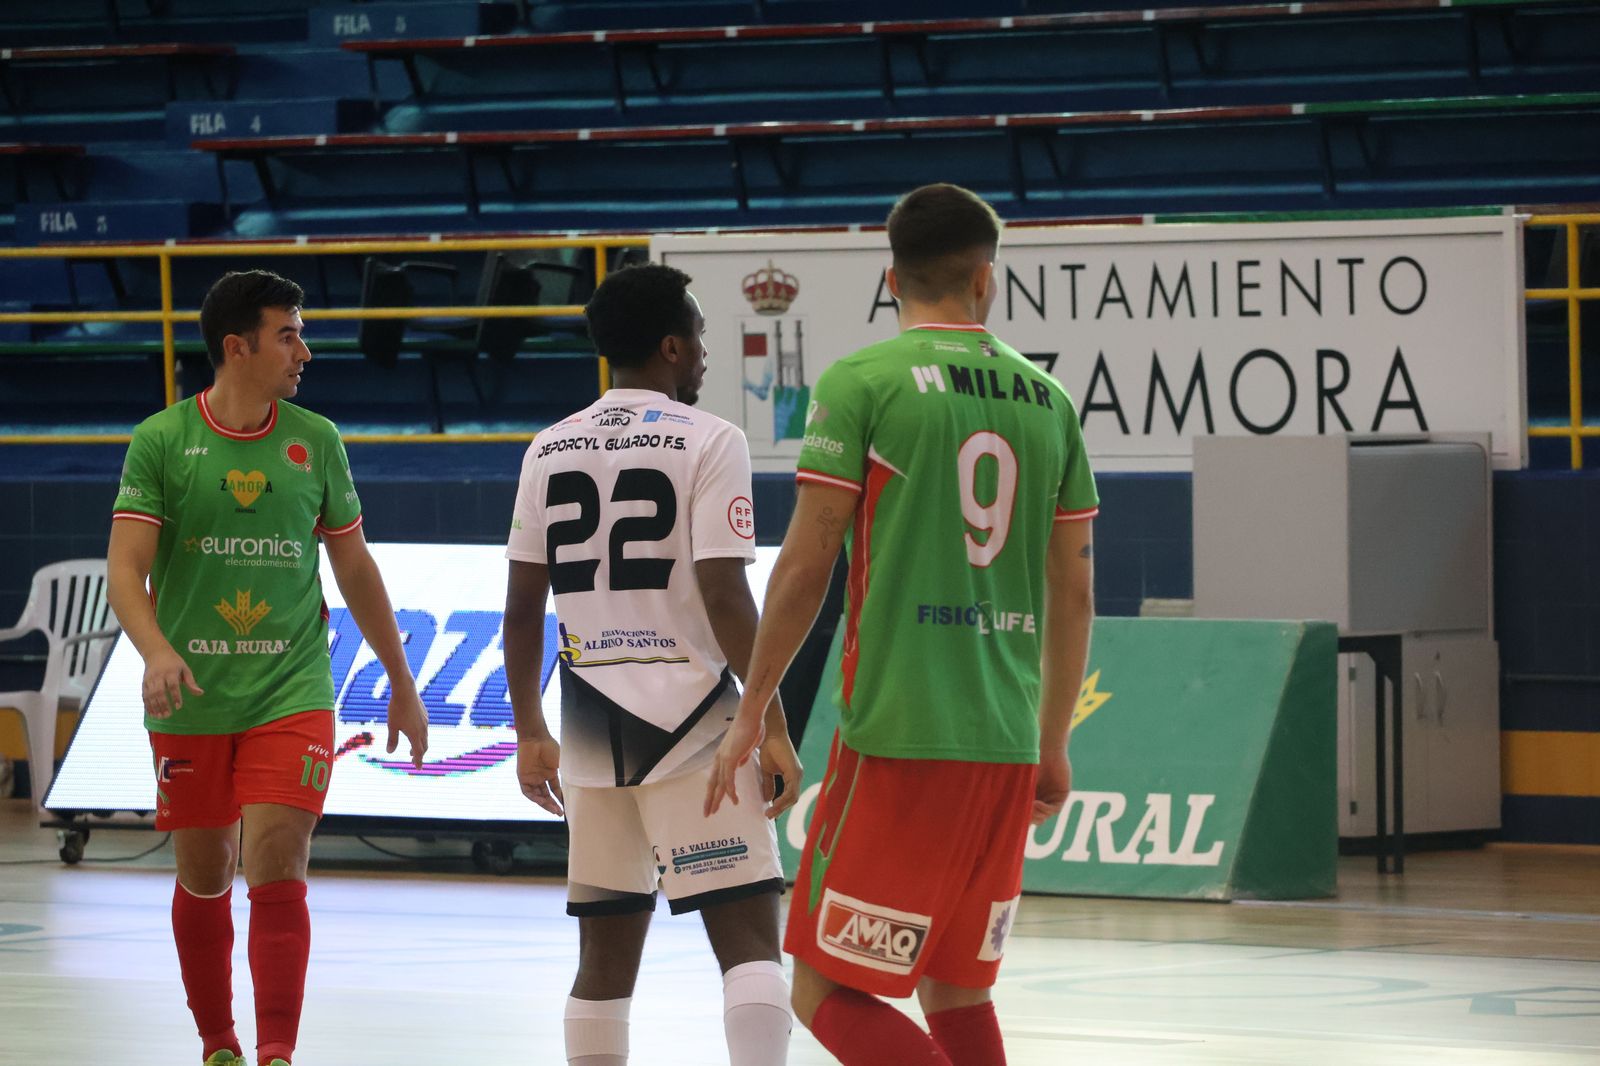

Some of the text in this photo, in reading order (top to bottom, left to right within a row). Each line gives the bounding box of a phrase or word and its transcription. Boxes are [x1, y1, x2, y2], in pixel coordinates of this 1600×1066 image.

[250, 114, 261, 134] 4
[867, 253, 1429, 324] ANTAMIENTO
[946, 363, 1054, 411] MILAR
[538, 434, 687, 459] DEPORCYL GUARDO F.S.
[219, 477, 274, 494] ZAMORA
[957, 429, 1018, 569] 9
[546, 467, 677, 596] 22
[200, 533, 303, 558] euronics
[187, 639, 232, 656] CAJA
[584, 637, 677, 651] ALBINO SANTOS
[301, 754, 329, 793] 10
[688, 838, 729, 854] VALLEJO
[824, 914, 918, 963] AMAQ
